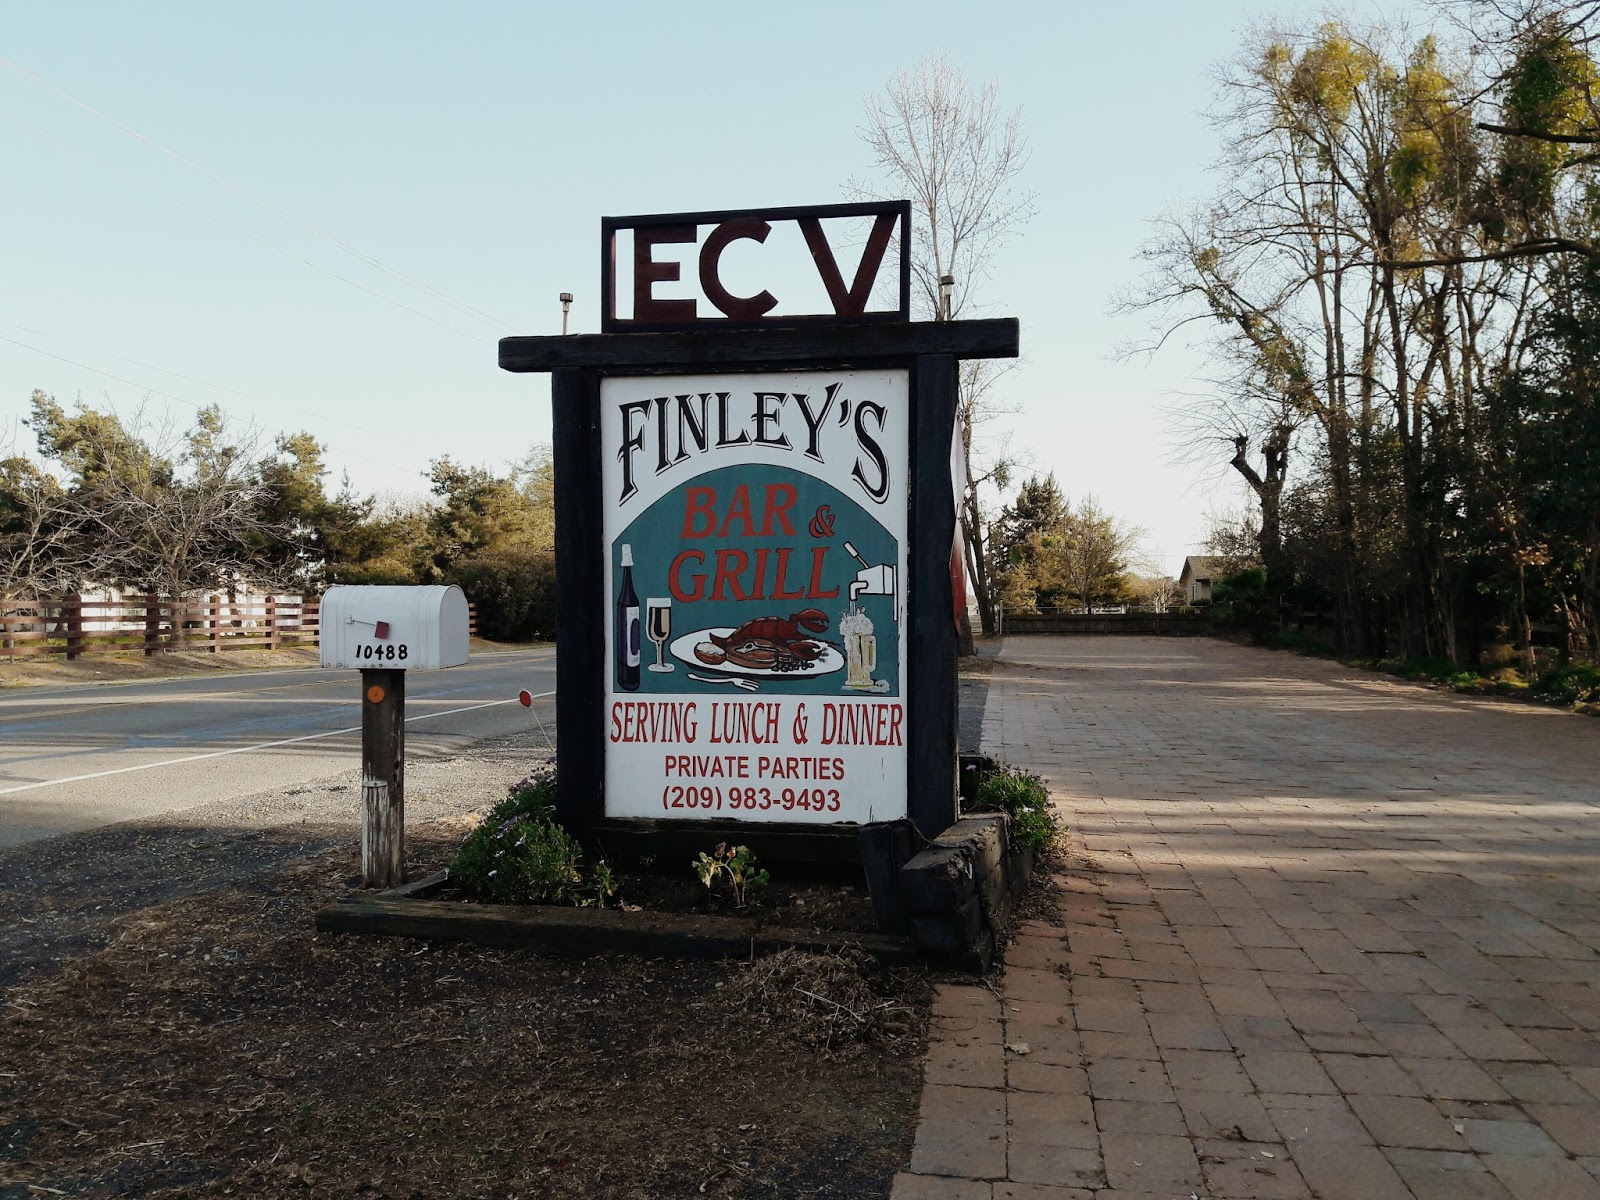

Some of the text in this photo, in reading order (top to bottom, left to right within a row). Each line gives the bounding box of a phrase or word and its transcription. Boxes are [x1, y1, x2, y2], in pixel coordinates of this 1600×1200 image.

[634, 213, 899, 321] ECV
[617, 382, 890, 507] FINLEY'S
[678, 483, 836, 539] BAR &
[668, 547, 841, 603] GRILL
[355, 644, 408, 660] 10488
[610, 701, 903, 747] SERVING LUNCH & DINNER
[665, 755, 845, 780] PRIVATE PARTIES
[662, 786, 841, 812] (209) 983-9493
